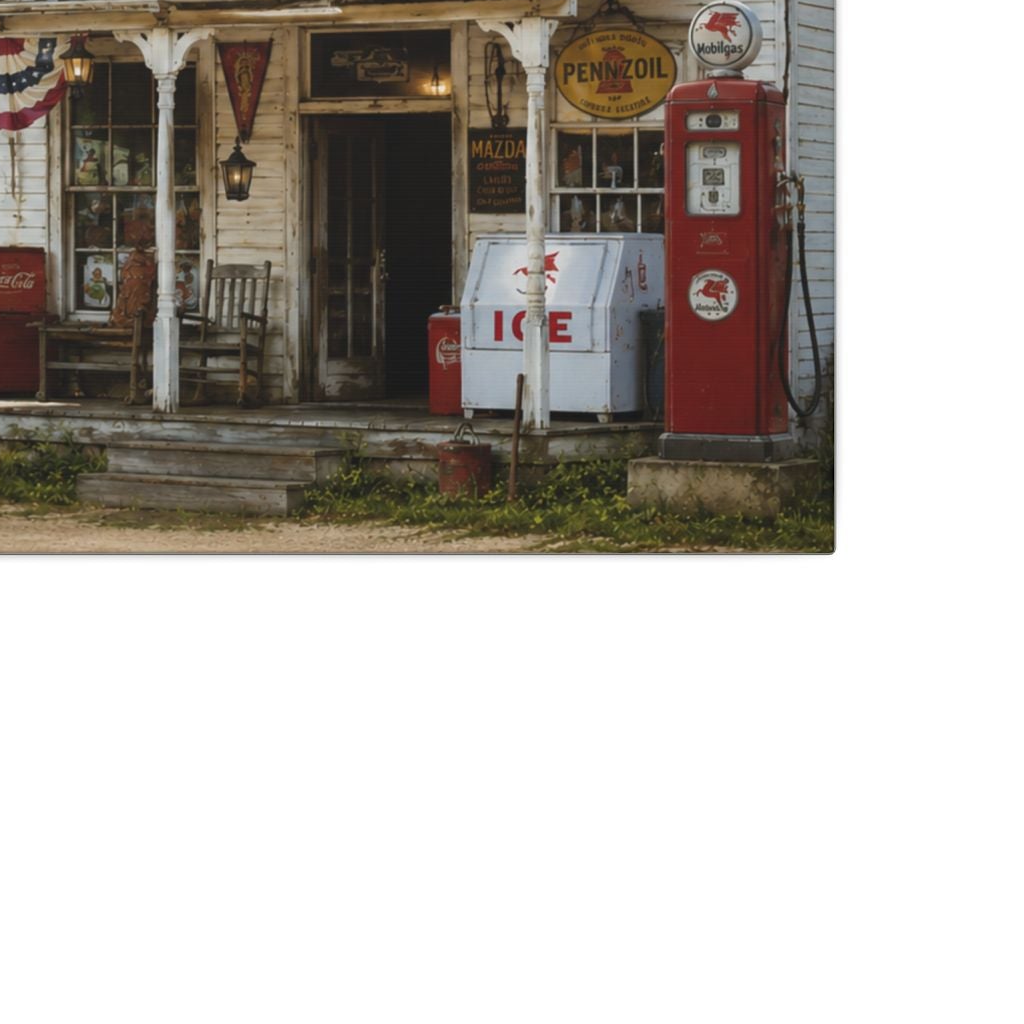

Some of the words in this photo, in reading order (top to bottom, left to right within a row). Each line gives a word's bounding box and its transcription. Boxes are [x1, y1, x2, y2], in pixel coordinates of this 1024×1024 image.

[697, 40, 743, 57] Mobilgas
[563, 57, 668, 85] PENNZOIL
[471, 140, 526, 159] MAZDA
